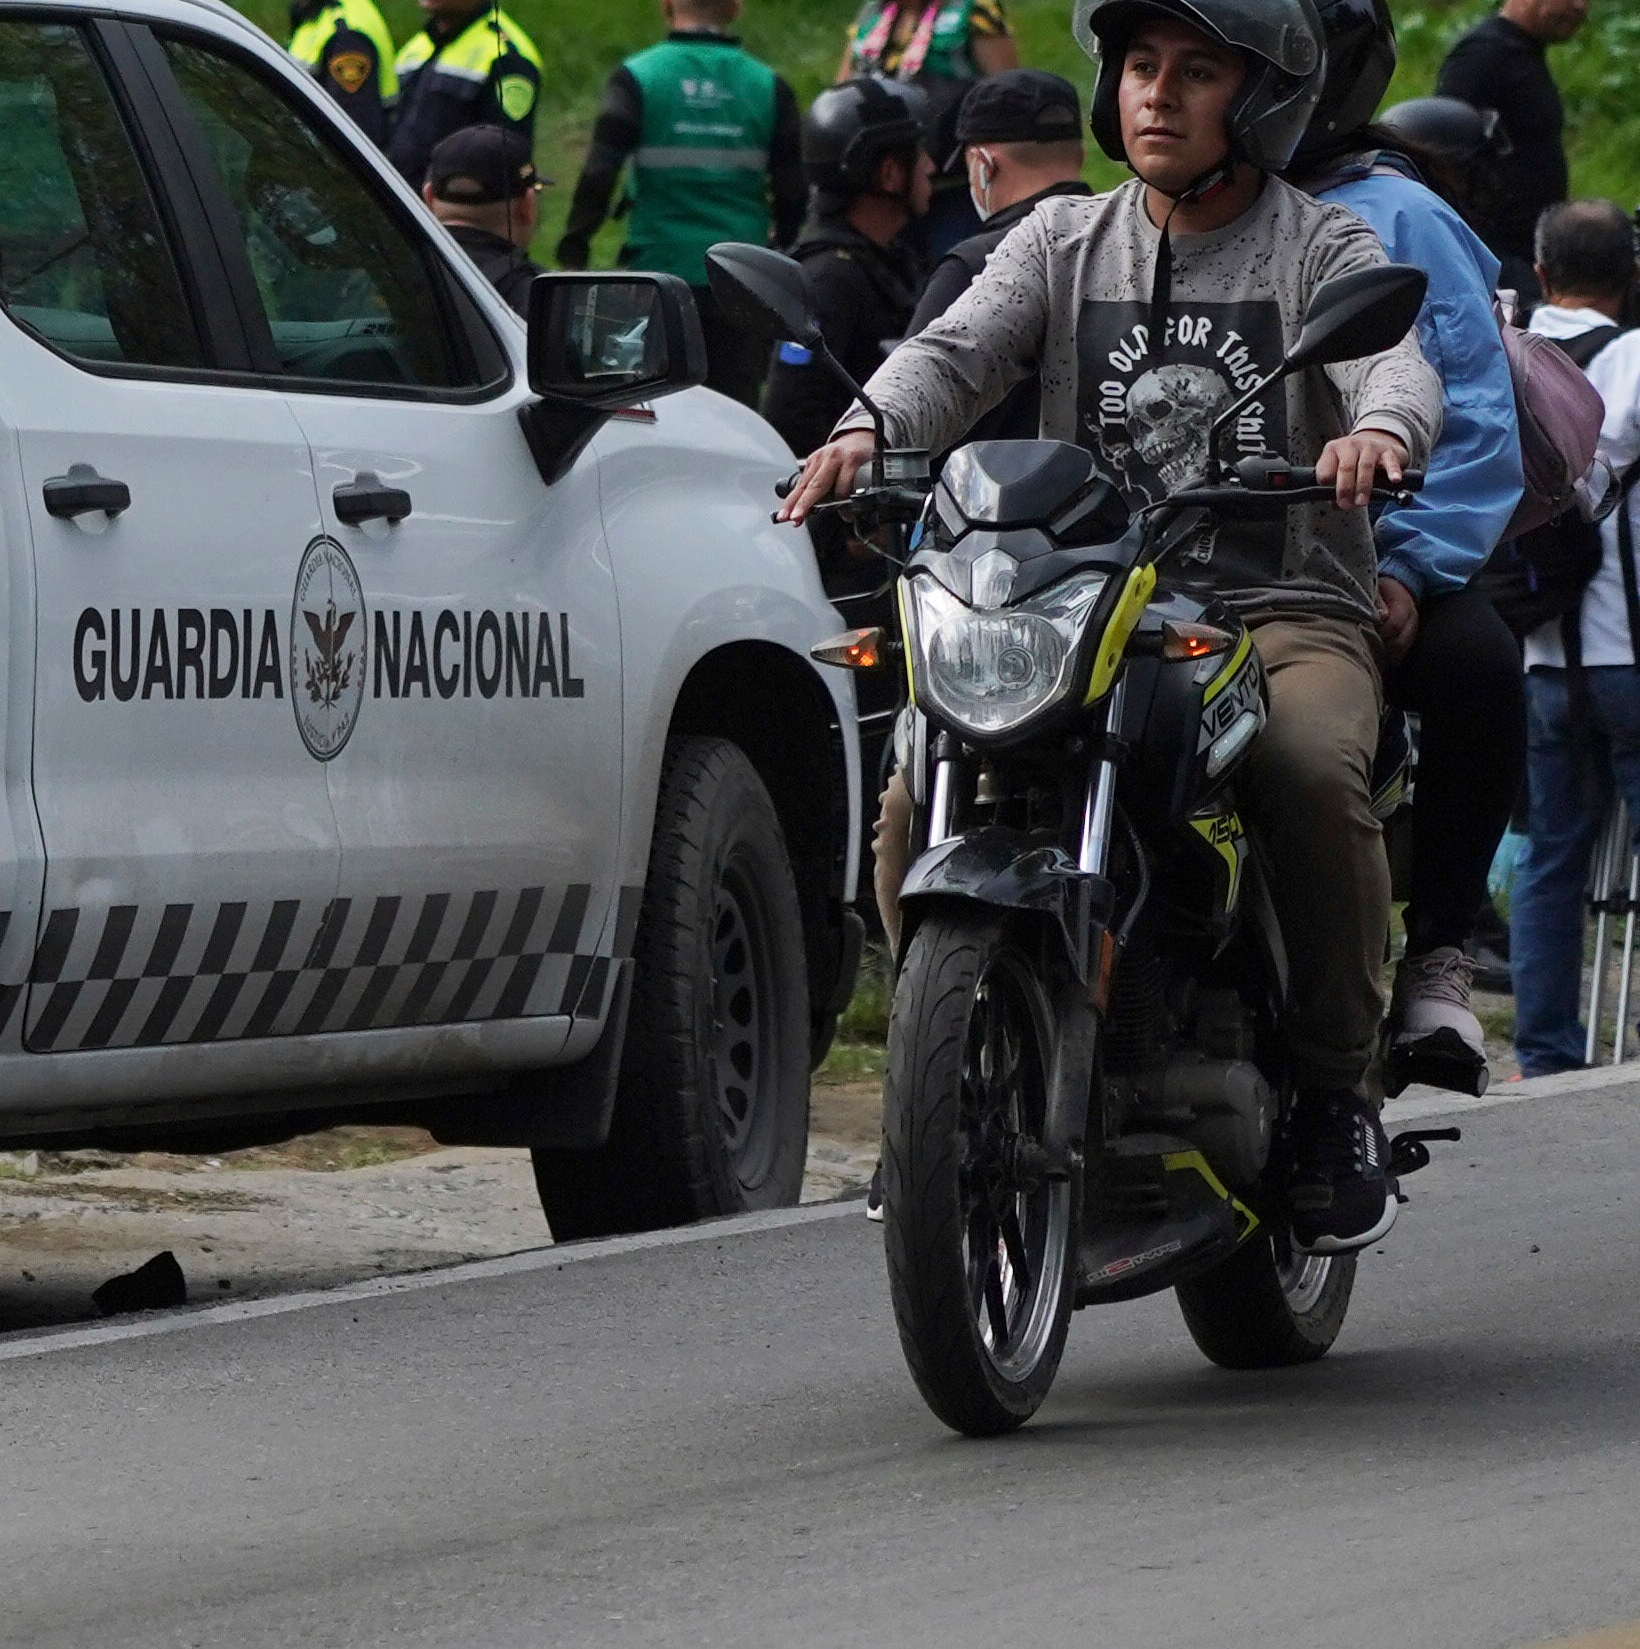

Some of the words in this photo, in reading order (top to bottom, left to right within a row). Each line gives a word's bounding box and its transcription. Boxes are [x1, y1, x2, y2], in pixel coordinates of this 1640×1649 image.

[1099, 380, 1127, 428] TOO
[1163, 314, 1213, 349] FOR
[72, 607, 284, 702] GUARDIA
[373, 609, 585, 699] NACIONAL
[1201, 662, 1258, 738] VENTO
